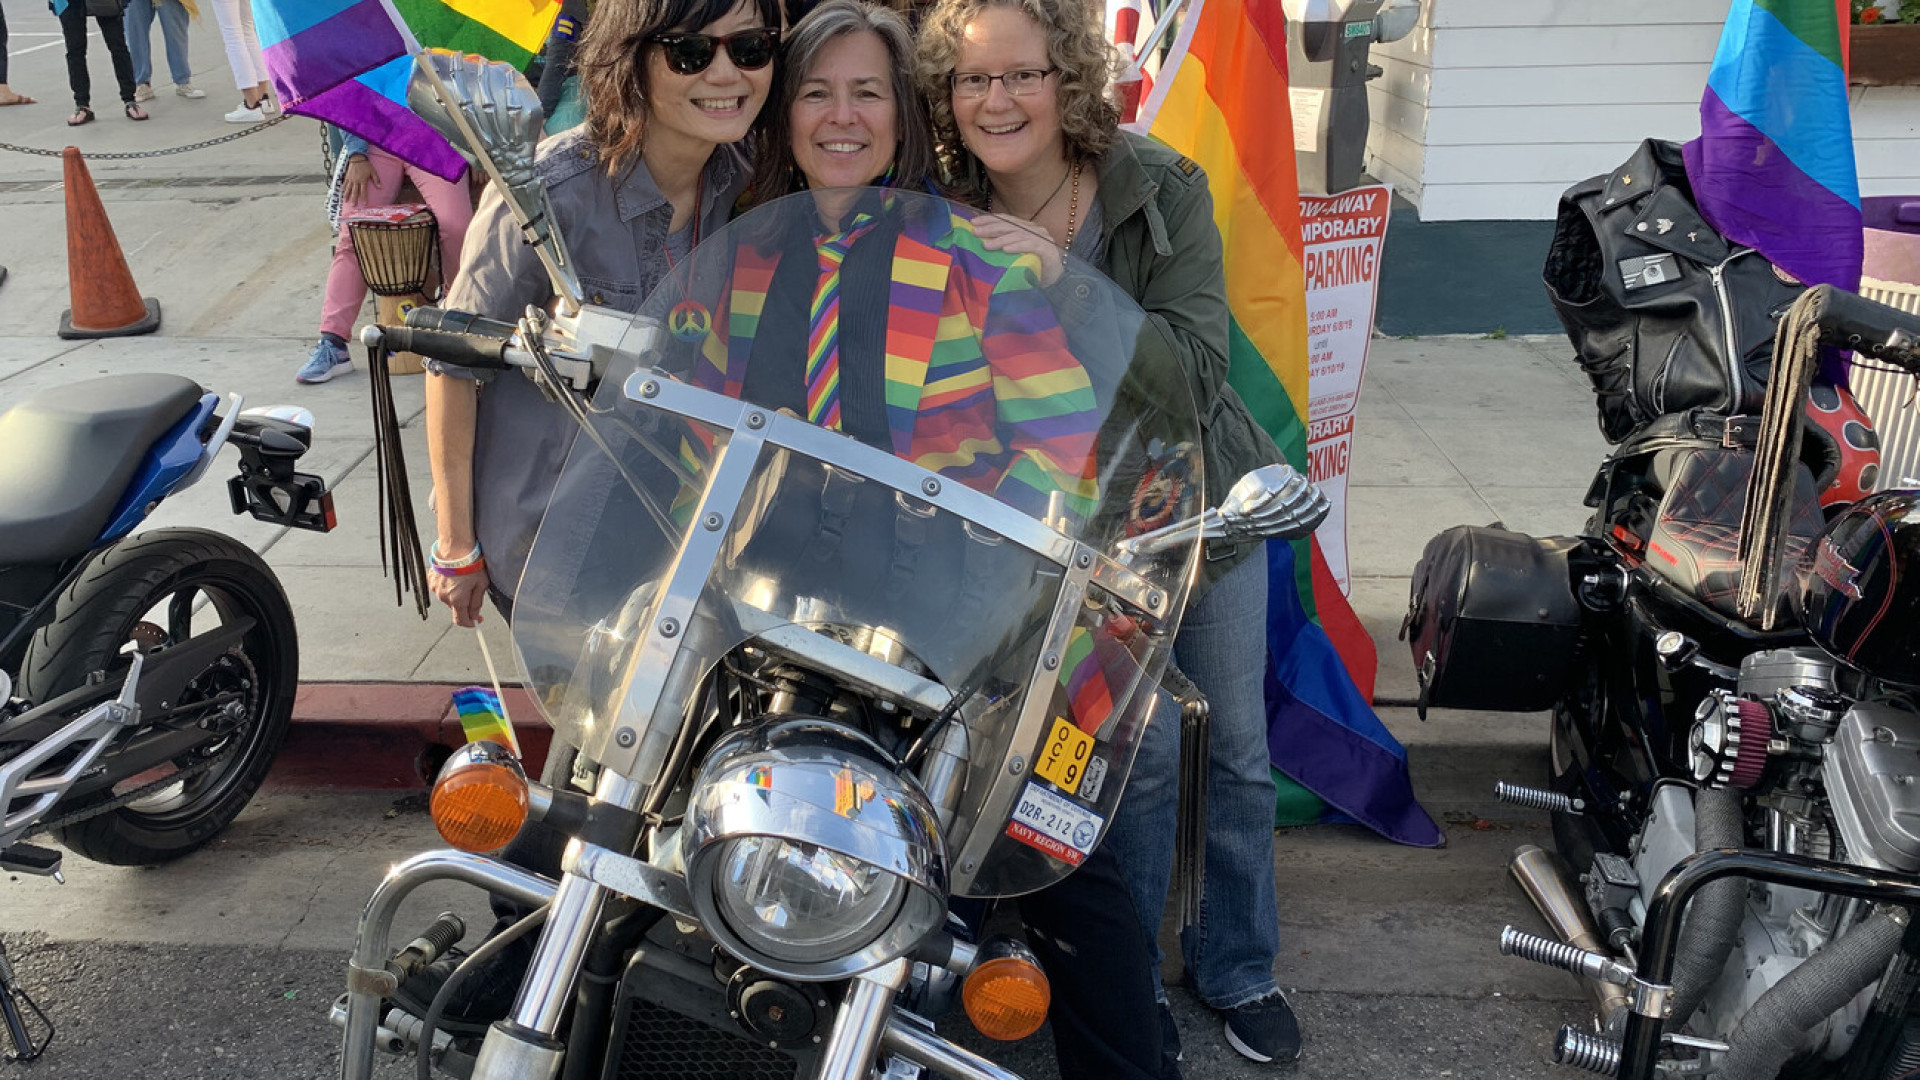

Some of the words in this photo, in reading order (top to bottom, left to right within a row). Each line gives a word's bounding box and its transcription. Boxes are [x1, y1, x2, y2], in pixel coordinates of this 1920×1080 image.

[1305, 244, 1373, 291] PARKING
[1326, 307, 1338, 319] AM
[1321, 350, 1333, 362] AM
[1011, 823, 1034, 840] NAVY
[1034, 833, 1066, 854] REGION
